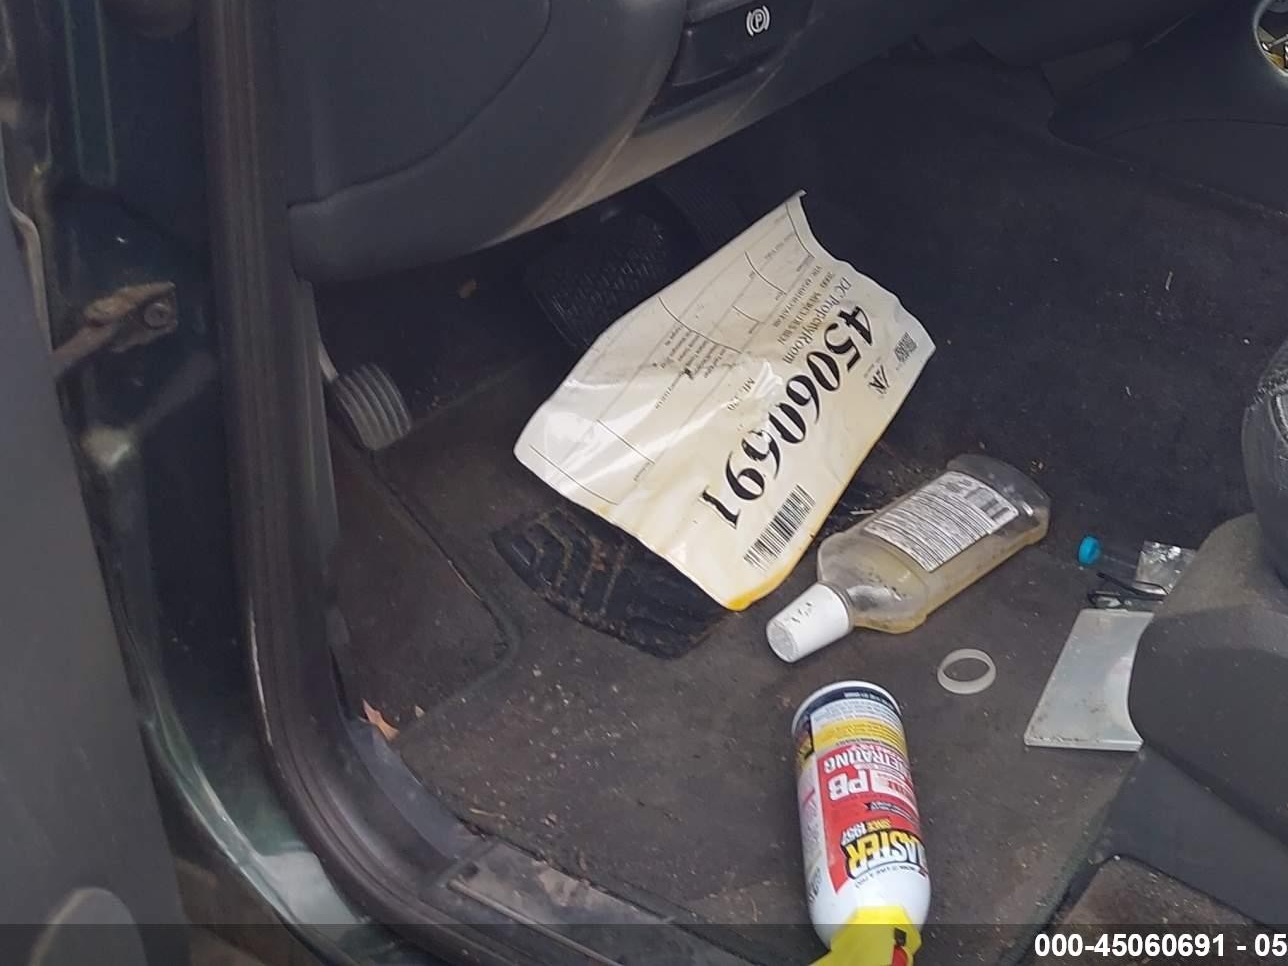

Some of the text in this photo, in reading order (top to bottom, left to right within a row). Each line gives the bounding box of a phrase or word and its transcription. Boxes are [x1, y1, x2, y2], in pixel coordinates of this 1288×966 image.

[699, 305, 873, 529] 45060691
[828, 769, 869, 801] PB
[846, 830, 928, 879] LASTER
